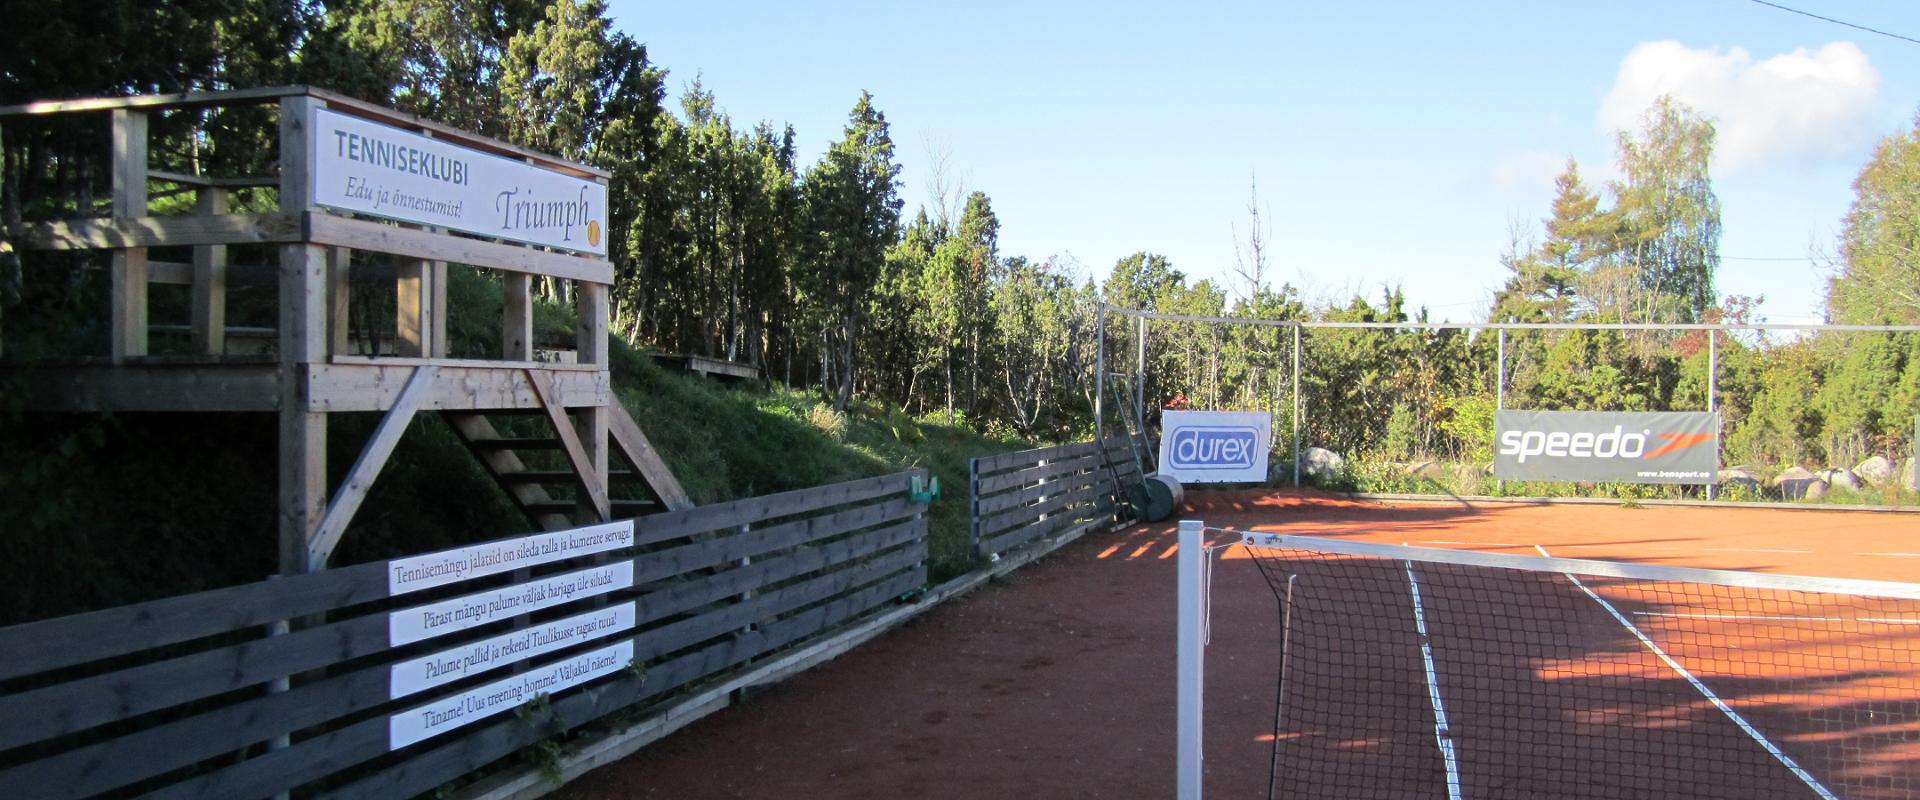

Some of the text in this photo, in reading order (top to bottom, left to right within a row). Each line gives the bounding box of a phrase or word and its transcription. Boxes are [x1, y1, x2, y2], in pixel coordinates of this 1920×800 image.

[334, 129, 467, 186] TENNISEKLUBI
[344, 176, 462, 219] Edu ja õnnestumist!
[496, 185, 589, 241] Triumph
[1178, 431, 1254, 466] durex
[1500, 425, 1645, 463] speedo
[394, 525, 631, 584] Tennisemängu jalatsid on sileda talla ja kumerate servaga!
[423, 570, 613, 629] Pärast mängu palume väljak harjaga üle siluda!
[425, 612, 617, 679] Palume pallid ja reketid Tuulikusse tagasi tuua!
[422, 650, 617, 729] Täname! Uus treening homme! Väljakul näeme!
